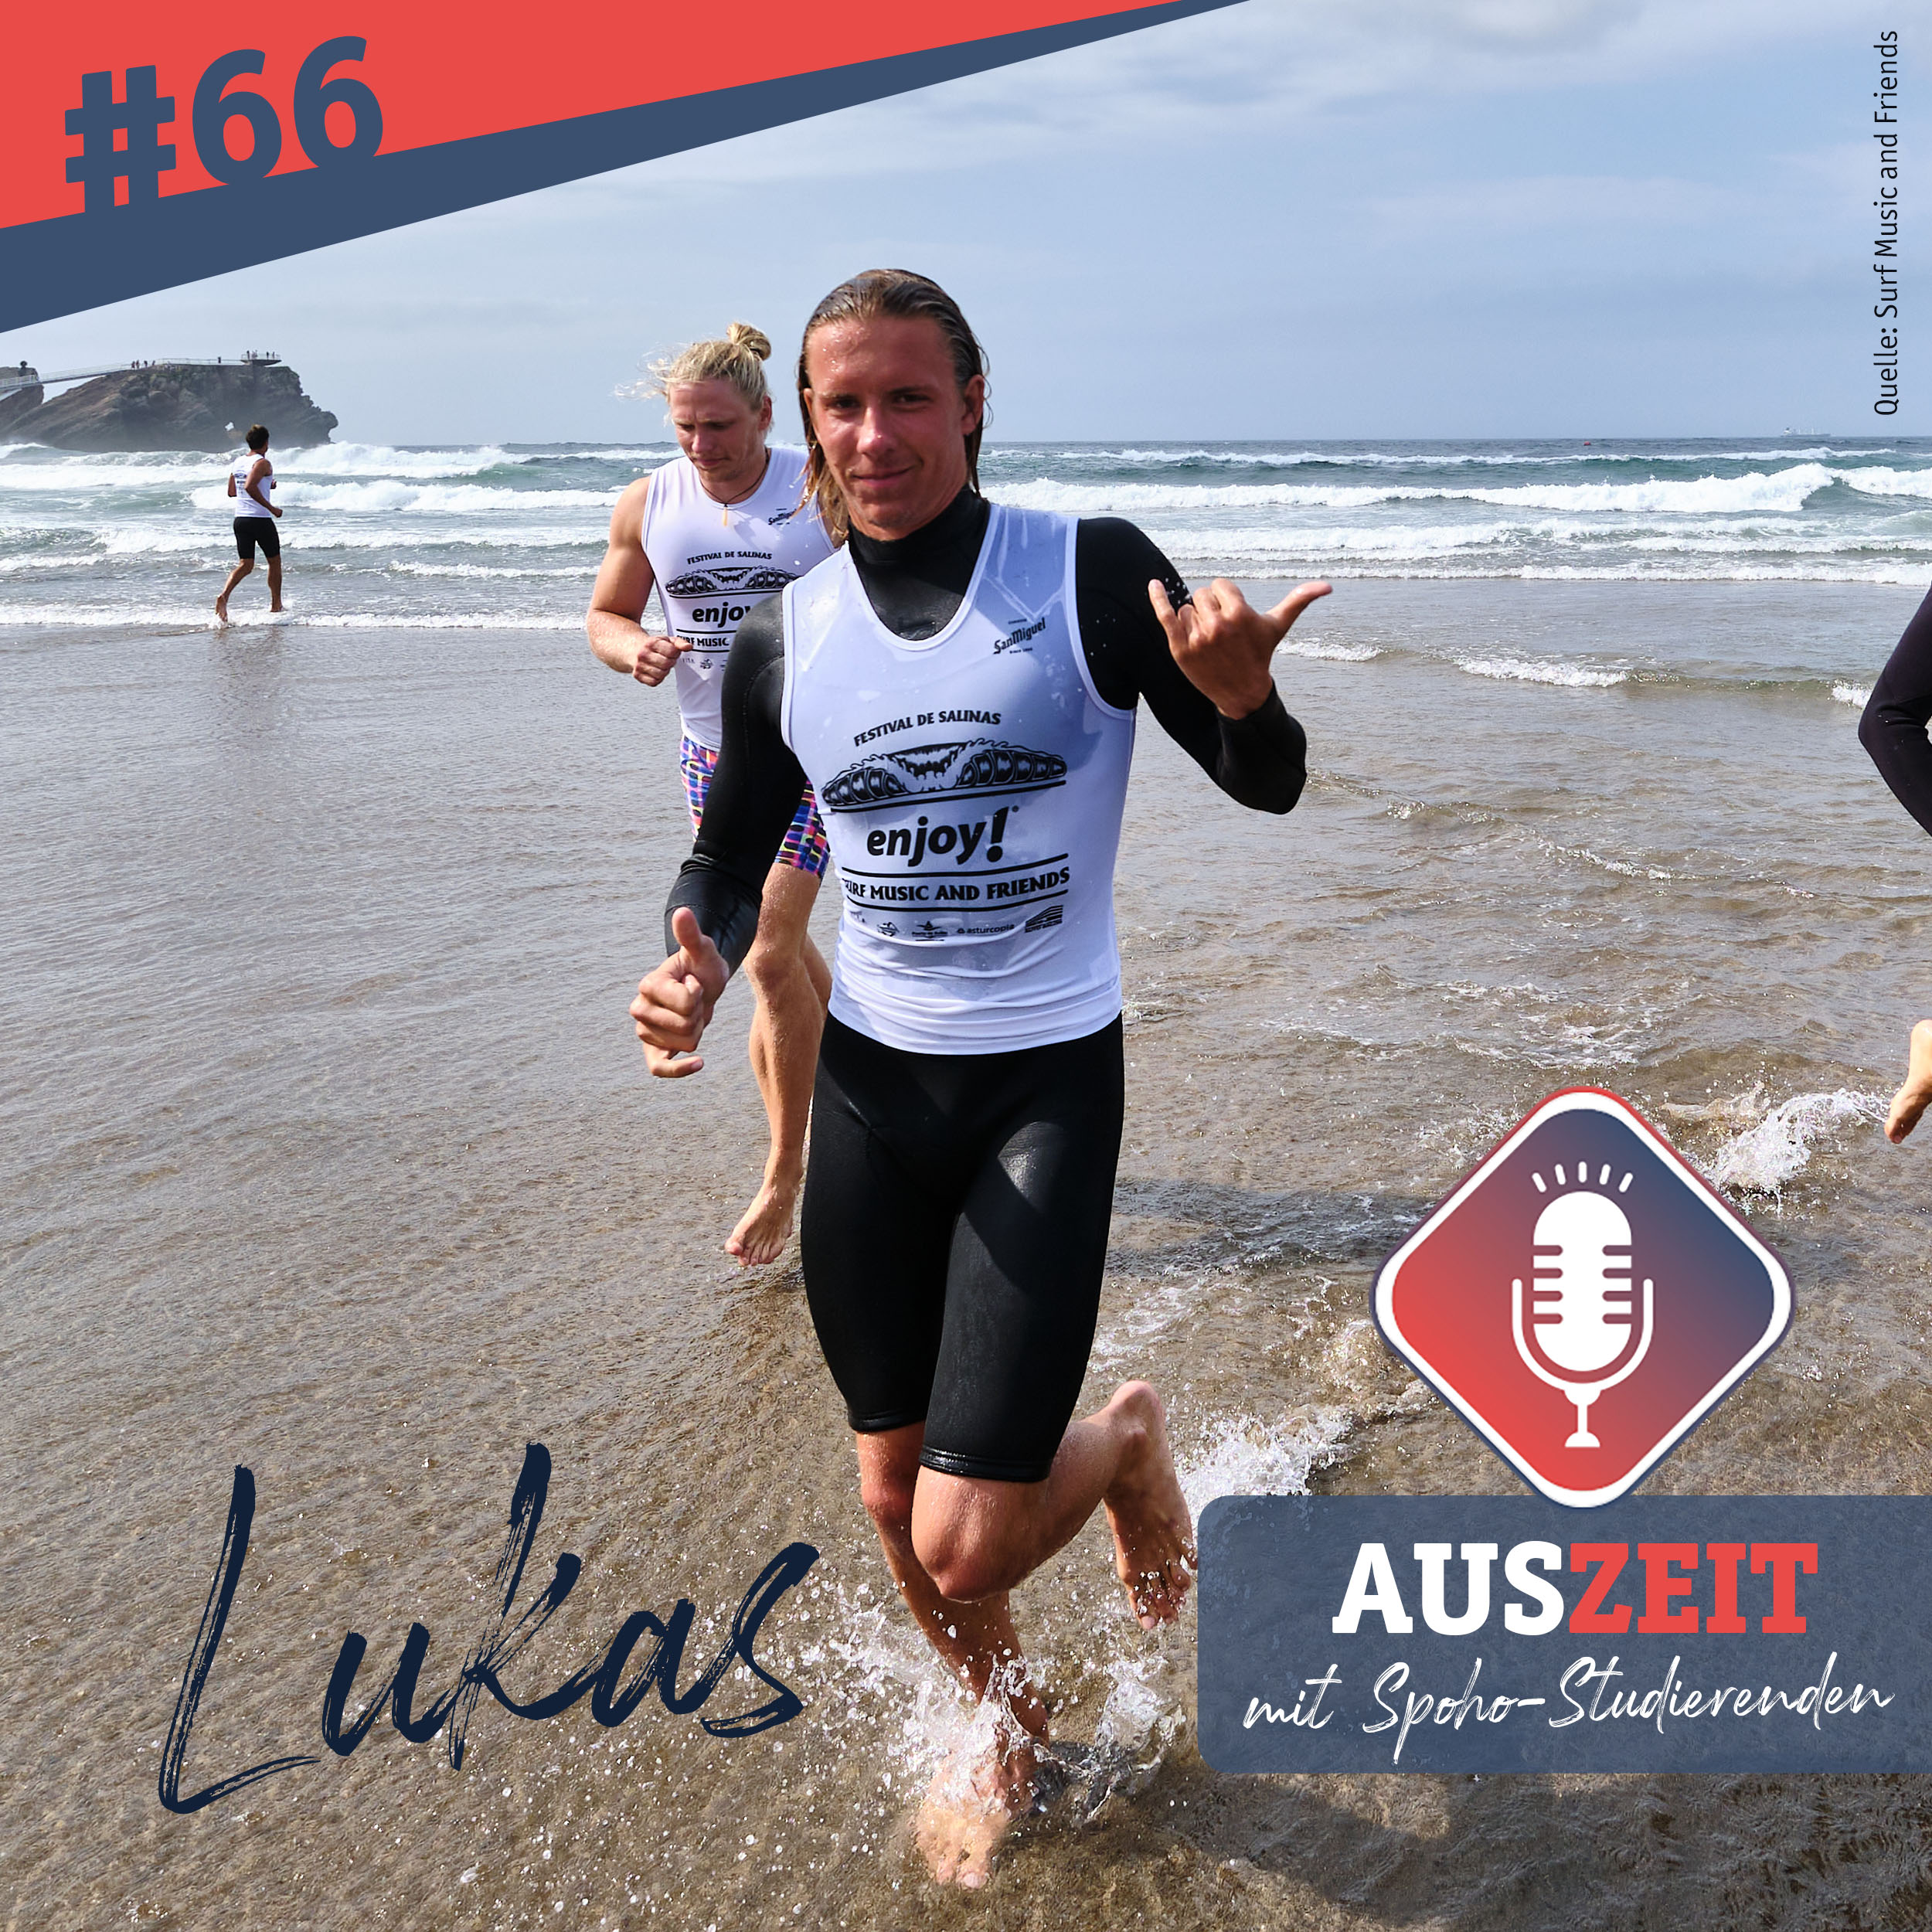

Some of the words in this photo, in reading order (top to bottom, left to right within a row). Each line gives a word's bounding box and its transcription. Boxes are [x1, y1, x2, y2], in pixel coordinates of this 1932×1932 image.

[687, 553, 722, 565] FESTIVAL
[737, 551, 773, 560] SALINAS
[697, 638, 730, 647] MUSIC
[854, 716, 913, 747] FESTIVAL
[917, 713, 934, 726] DE
[938, 709, 1002, 725] SALINAS
[867, 806, 1009, 867] enjoy!
[870, 885, 930, 901] MUSIC
[934, 885, 981, 901] AND
[986, 866, 1070, 900] FRIENDS
